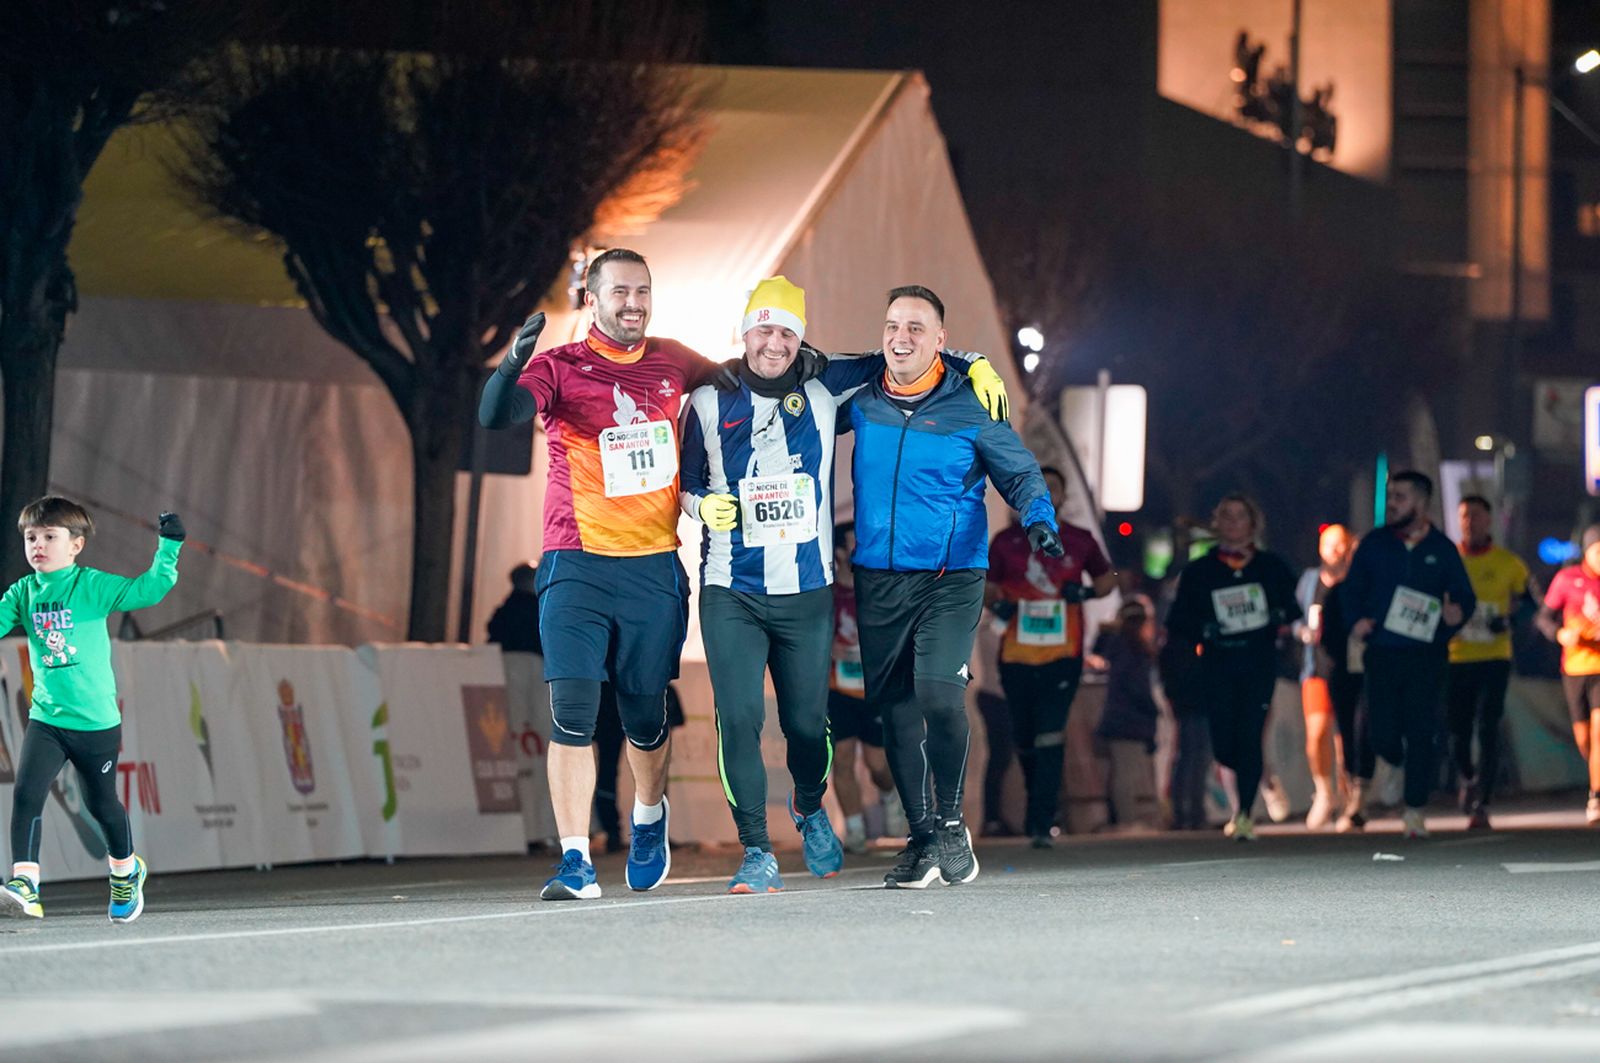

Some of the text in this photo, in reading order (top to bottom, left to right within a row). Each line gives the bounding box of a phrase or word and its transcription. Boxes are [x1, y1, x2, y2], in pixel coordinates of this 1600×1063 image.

[616, 432, 638, 441] NOCHE
[640, 431, 648, 439] DE
[608, 442, 625, 451] SAN
[627, 448, 655, 470] 111
[756, 483, 778, 491] NOCHE
[748, 493, 763, 502] SAN
[755, 499, 805, 522] 6526
[32, 610, 74, 631] FIRE
